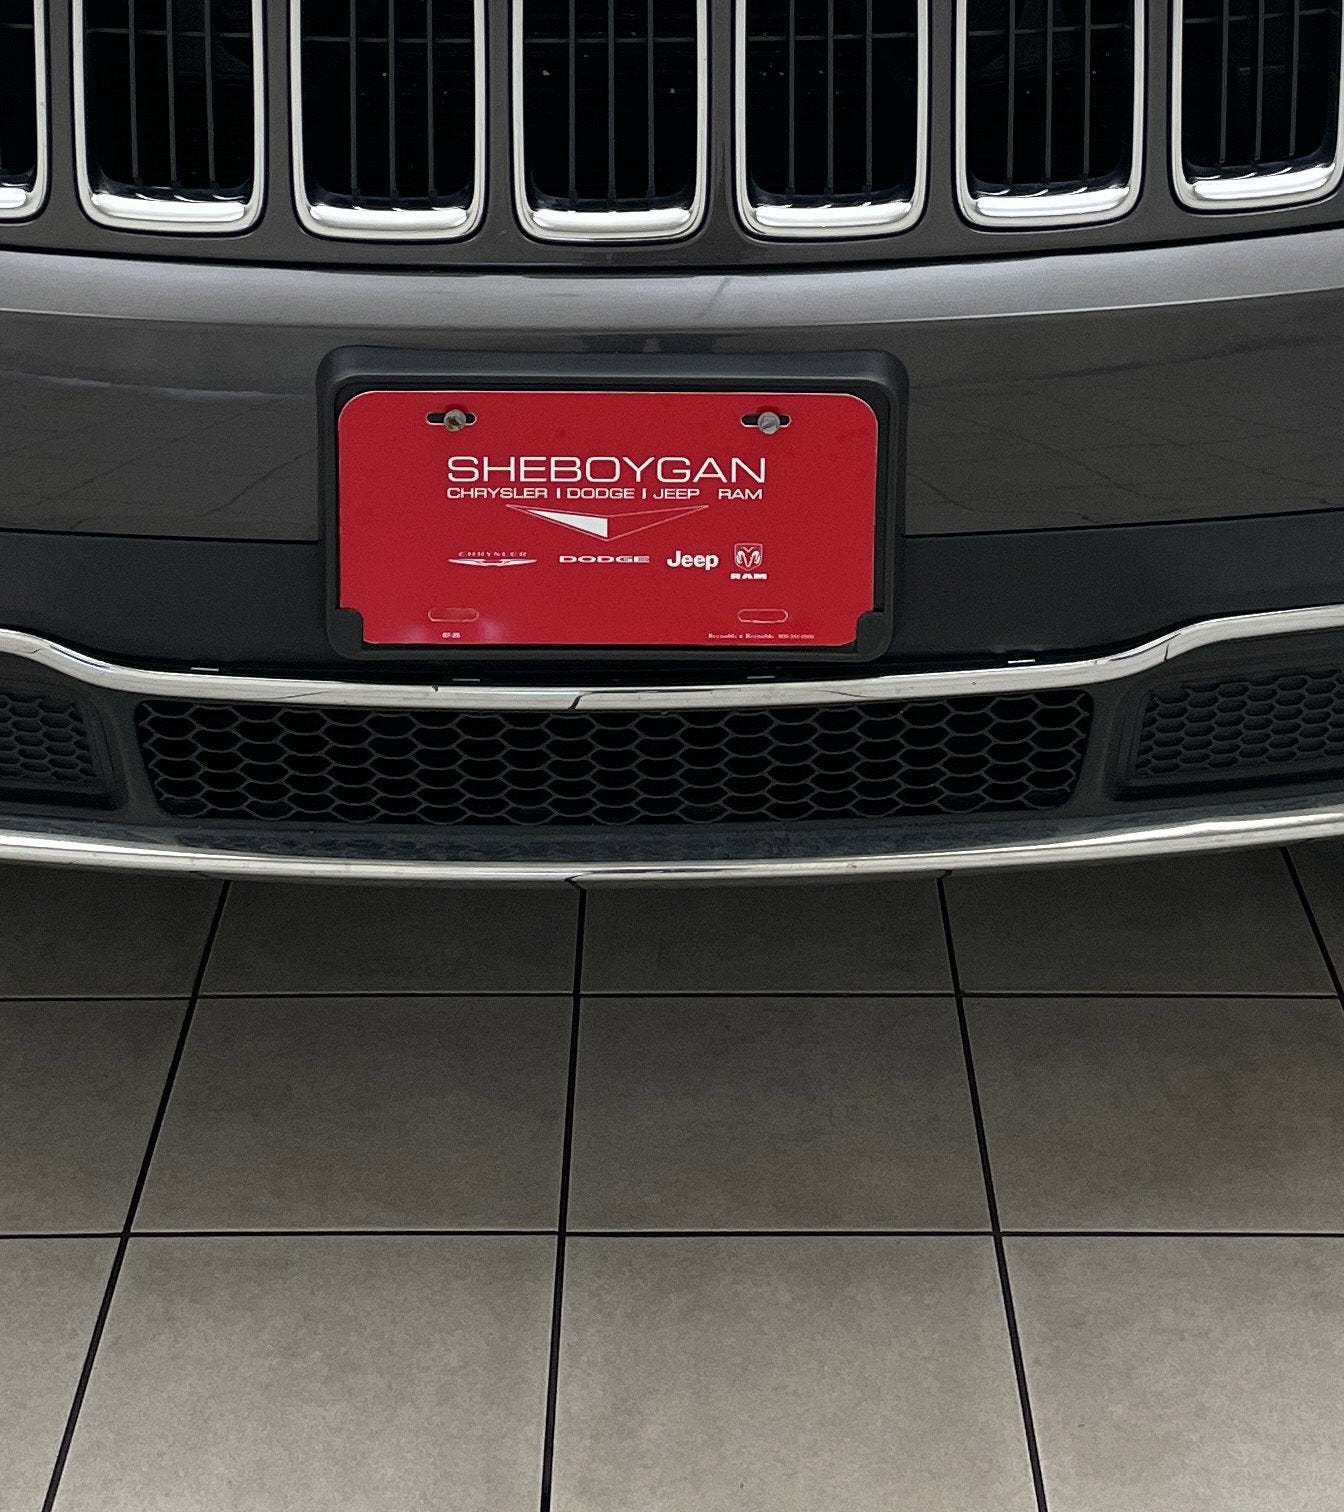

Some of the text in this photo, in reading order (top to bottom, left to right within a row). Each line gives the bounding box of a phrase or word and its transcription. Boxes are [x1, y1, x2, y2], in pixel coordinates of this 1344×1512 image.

[447, 456, 766, 484] SHEBOYGAN
[447, 487, 548, 499] CHRYSLER
[566, 488, 635, 499] DODGE
[653, 488, 700, 500] JEEP
[718, 488, 763, 500] RAM
[559, 555, 650, 563] DODGE
[666, 550, 719, 571] Jeep
